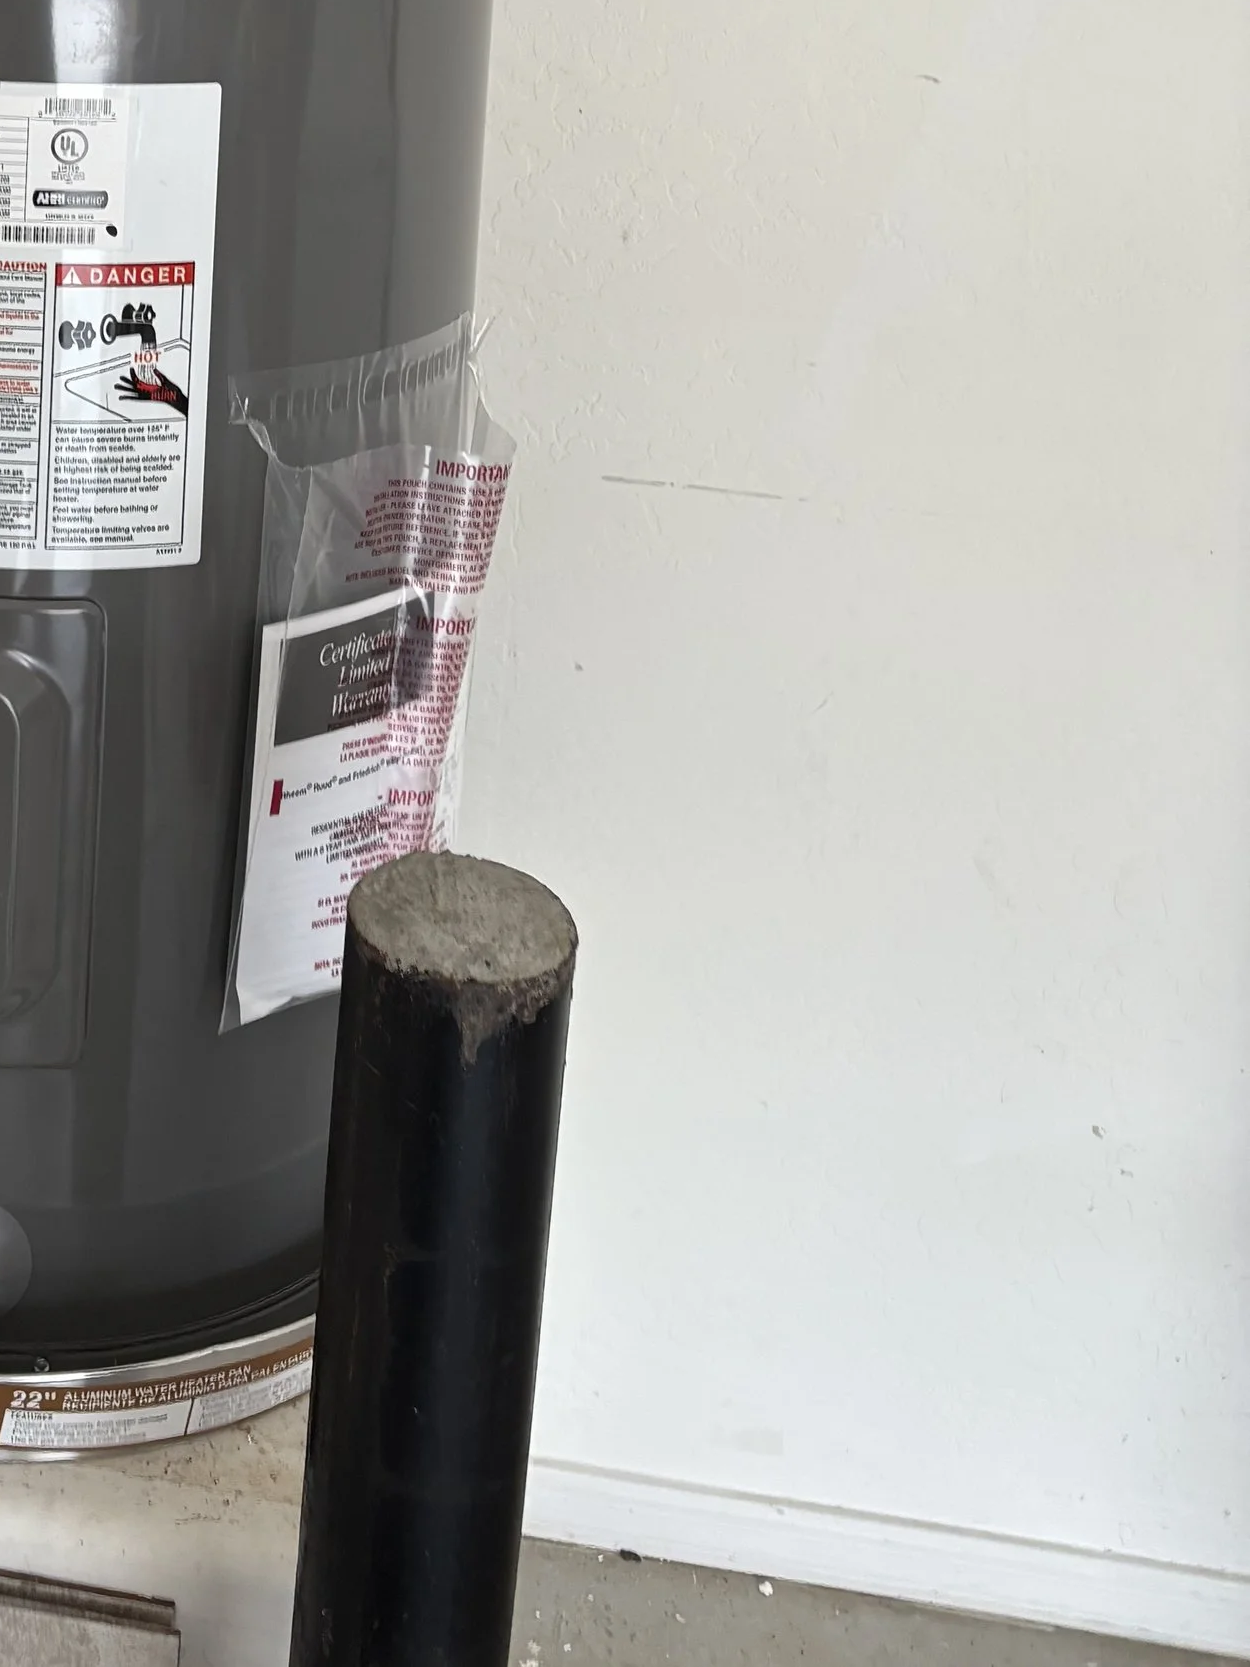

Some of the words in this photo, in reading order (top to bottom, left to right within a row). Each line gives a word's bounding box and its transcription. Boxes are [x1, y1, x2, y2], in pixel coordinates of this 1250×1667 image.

[90, 266, 186, 284] DANGER
[134, 351, 161, 363] HOT
[55, 426, 77, 434] Water
[80, 426, 126, 436] temperature
[55, 436, 69, 444] can
[71, 436, 94, 444] cause
[124, 433, 146, 443] burns
[147, 433, 179, 443] instantly
[65, 444, 87, 452] death
[88, 444, 107, 452] from
[54, 456, 90, 466] Children,
[91, 456, 124, 464] disabled
[126, 455, 140, 463] and
[141, 454, 167, 464] elderly
[168, 454, 181, 462] are
[63, 465, 93, 475] highest
[94, 465, 109, 473] risk
[110, 465, 118, 473] of
[120, 464, 141, 474] being
[54, 476, 68, 485] See
[70, 476, 112, 484] instruction
[113, 475, 141, 483] manual
[143, 475, 167, 483] before
[53, 486, 80, 495] setting
[81, 485, 128, 496] temperature
[129, 485, 137, 493] at
[139, 485, 159, 493] water
[402, 479, 427, 488] POUCH
[429, 481, 466, 495] CONTAINS
[52, 495, 79, 503] heater.
[410, 491, 465, 505] INSTRUCTIONS
[467, 498, 483, 507] AND
[71, 506, 92, 514] water
[94, 505, 119, 513] before
[120, 504, 148, 514] bathing
[390, 502, 415, 510] PLEASE
[417, 502, 440, 513] LEAVE
[443, 506, 481, 519] ATTACHED
[453, 517, 480, 529] PLEASE
[52, 526, 100, 536] Temperature
[101, 525, 130, 535] limiting
[132, 525, 156, 533] valves
[51, 535, 87, 544] available,
[394, 534, 419, 544] POUCH,
[430, 537, 482, 551] REPLACEMENT
[403, 545, 432, 556] SERVICE
[414, 557, 467, 573] MONTGOMERY,
[387, 566, 410, 575] MODEL
[413, 568, 429, 577] AND
[431, 571, 456, 583] SERIAL
[410, 579, 451, 593] INSTALLER
[453, 586, 468, 594] AND
[320, 629, 393, 667] Certificate
[337, 652, 391, 688] Limited
[338, 774, 351, 785] and
[295, 847, 313, 862] WITH
[313, 846, 318, 855] A
[10, 1390, 56, 1409] 22"
[64, 1387, 132, 1403] ALUMINUM
[135, 1382, 177, 1398] WATER
[180, 1370, 226, 1386] HEATER
[229, 1364, 251, 1378] PAN
